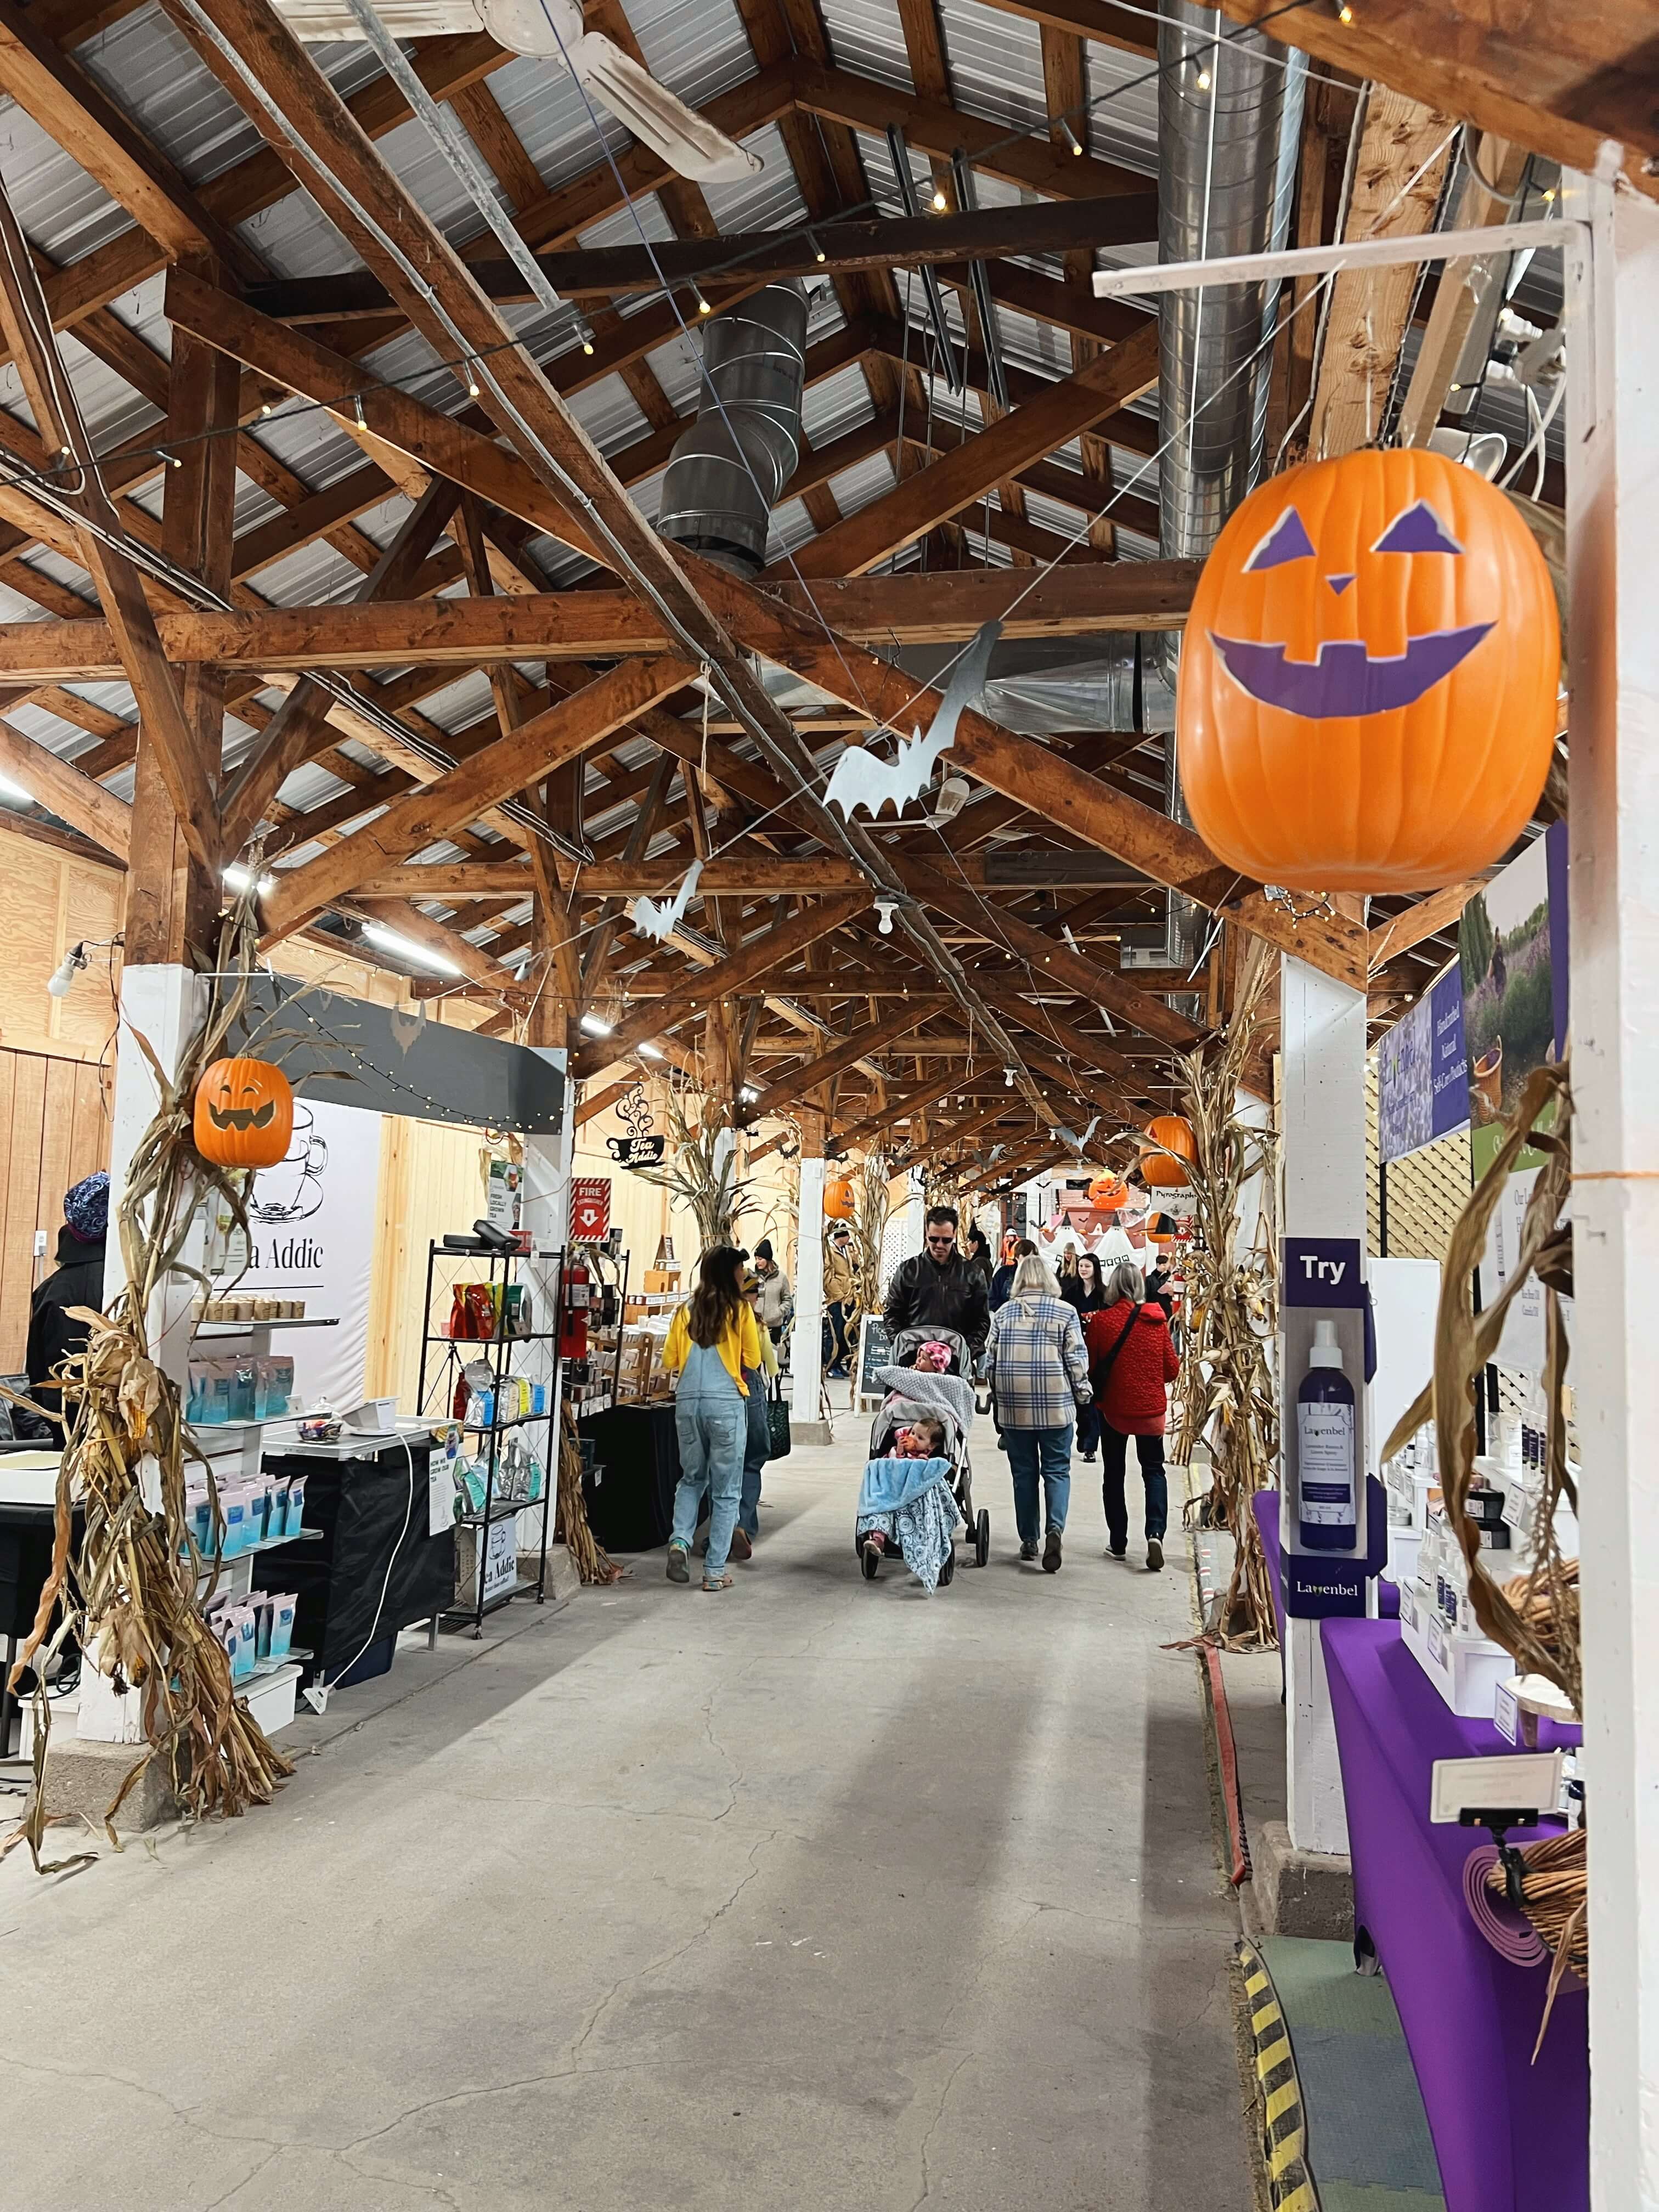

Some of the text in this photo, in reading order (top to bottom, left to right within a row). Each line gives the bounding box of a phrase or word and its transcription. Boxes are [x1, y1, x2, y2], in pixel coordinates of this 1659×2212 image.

[630, 1137, 654, 1153] Tea
[579, 1187, 602, 1196] FIRE
[1156, 1190, 1197, 1200] Pyrograph
[265, 1238, 324, 1269] Addic
[1300, 1255, 1346, 1285] Try
[495, 1555, 515, 1580] Addic
